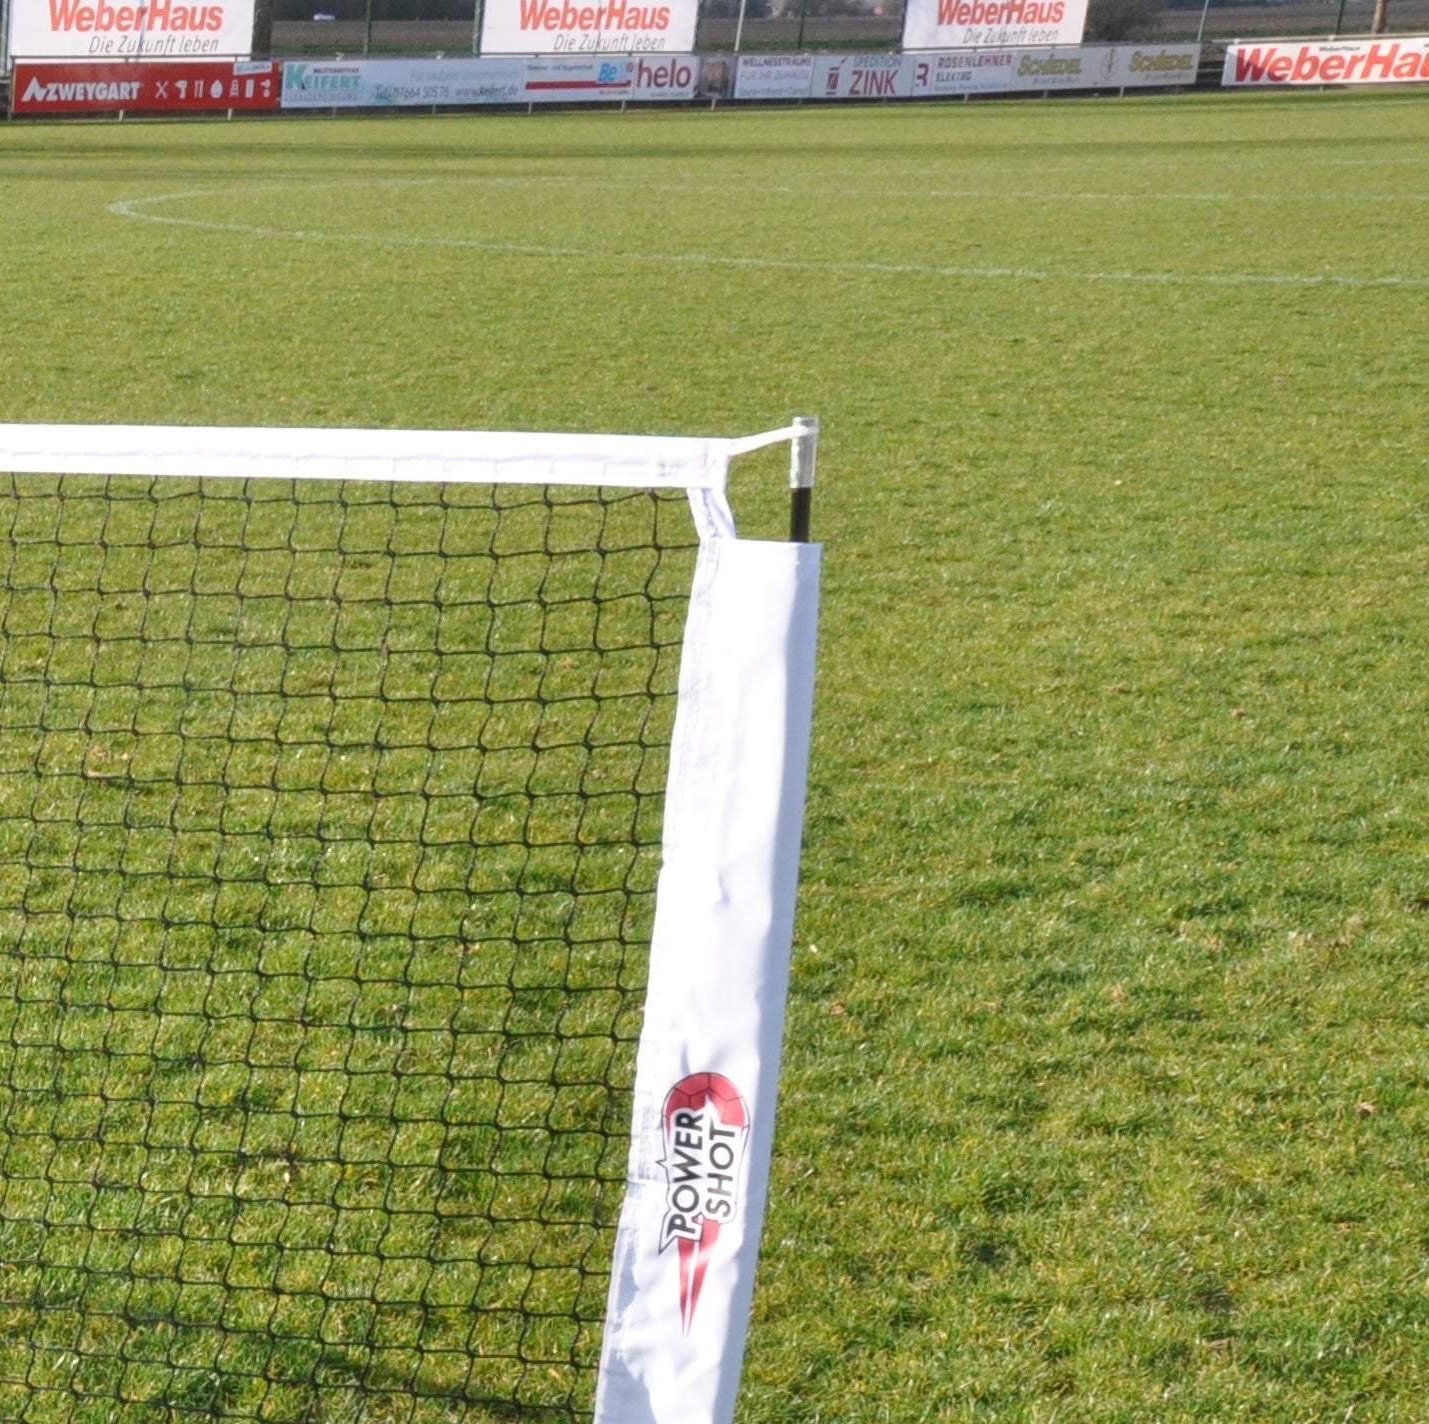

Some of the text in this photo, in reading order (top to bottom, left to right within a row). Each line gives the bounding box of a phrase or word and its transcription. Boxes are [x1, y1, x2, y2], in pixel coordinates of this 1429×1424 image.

[50, 0, 223, 32] WeberHaus
[519, 0, 670, 30] WeberHaus
[937, 0, 1065, 26] WeberHaus
[89, 34, 218, 55] Die Zukunft leben
[553, 33, 665, 51] Die Zukunft leben
[963, 26, 1059, 45] Die Zukunft leben
[636, 58, 691, 88] helo
[938, 54, 1012, 69] ROSENLEHNER
[285, 63, 361, 90] KEIFERT
[849, 69, 898, 96] ZINK
[936, 71, 971, 82] ELEKTRO
[46, 82, 140, 101] ZWEYGART
[665, 1110, 705, 1235] POWER
[704, 1114, 737, 1219] SHOT
